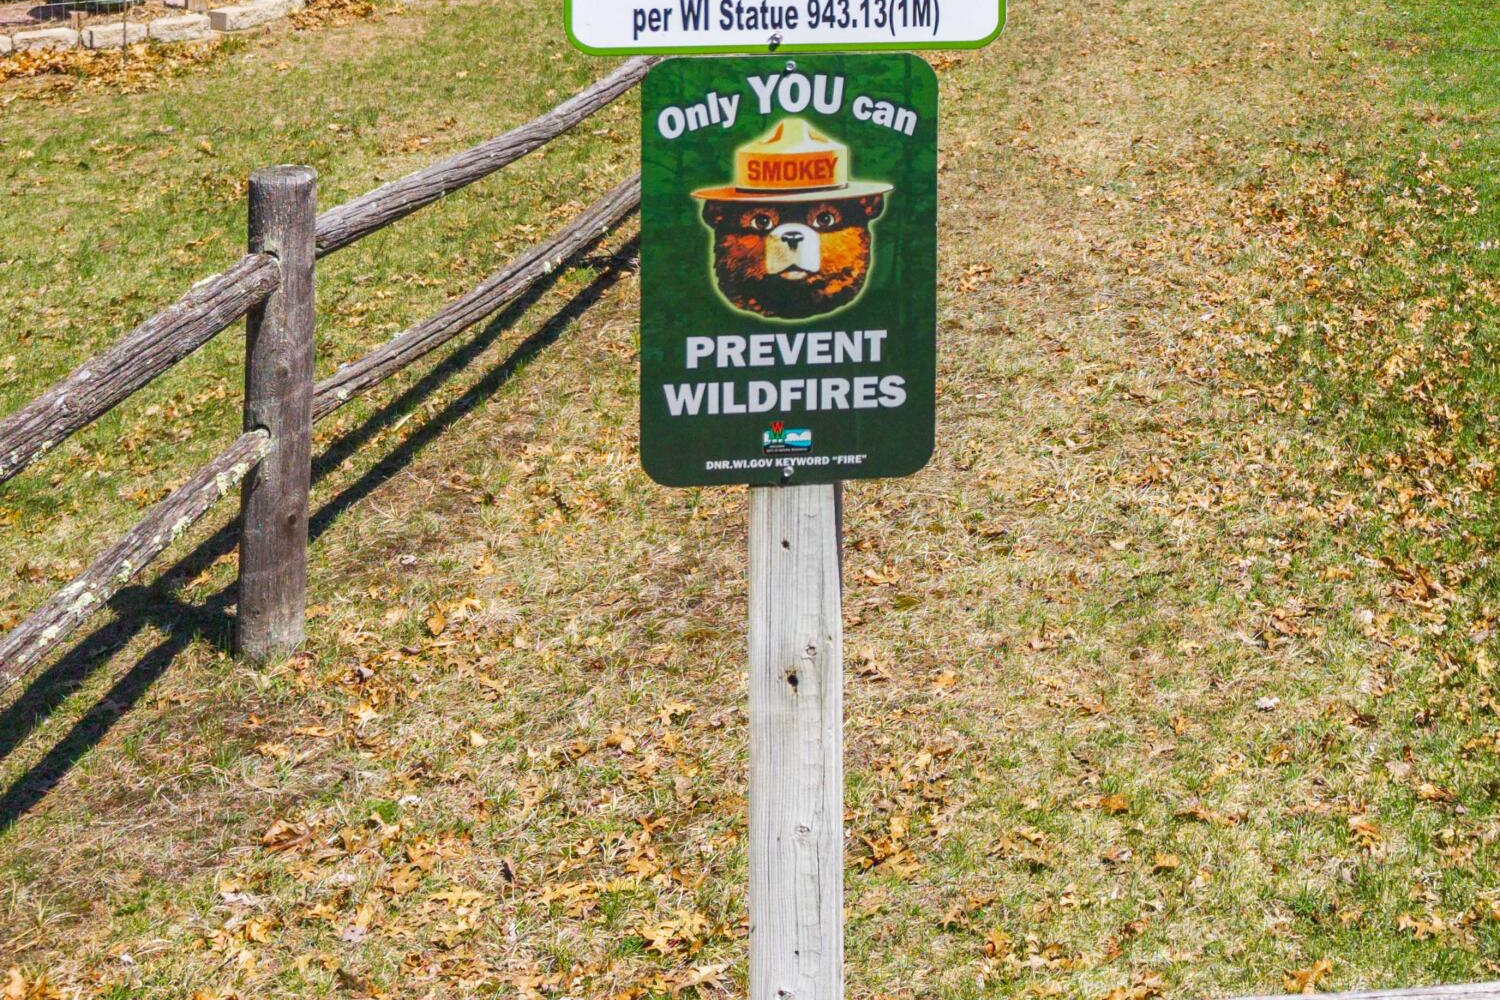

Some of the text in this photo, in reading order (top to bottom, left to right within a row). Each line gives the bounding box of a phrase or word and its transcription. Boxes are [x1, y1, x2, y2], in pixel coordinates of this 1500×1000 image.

[633, 5, 672, 40] per
[657, 73, 918, 140] Only YOU can
[747, 157, 838, 181] SMOKEY
[685, 330, 888, 369] PREVENT
[663, 375, 907, 416] WILDFIRES
[706, 458, 773, 470] DNR.WI.GOV
[775, 456, 830, 467] KEYWORD
